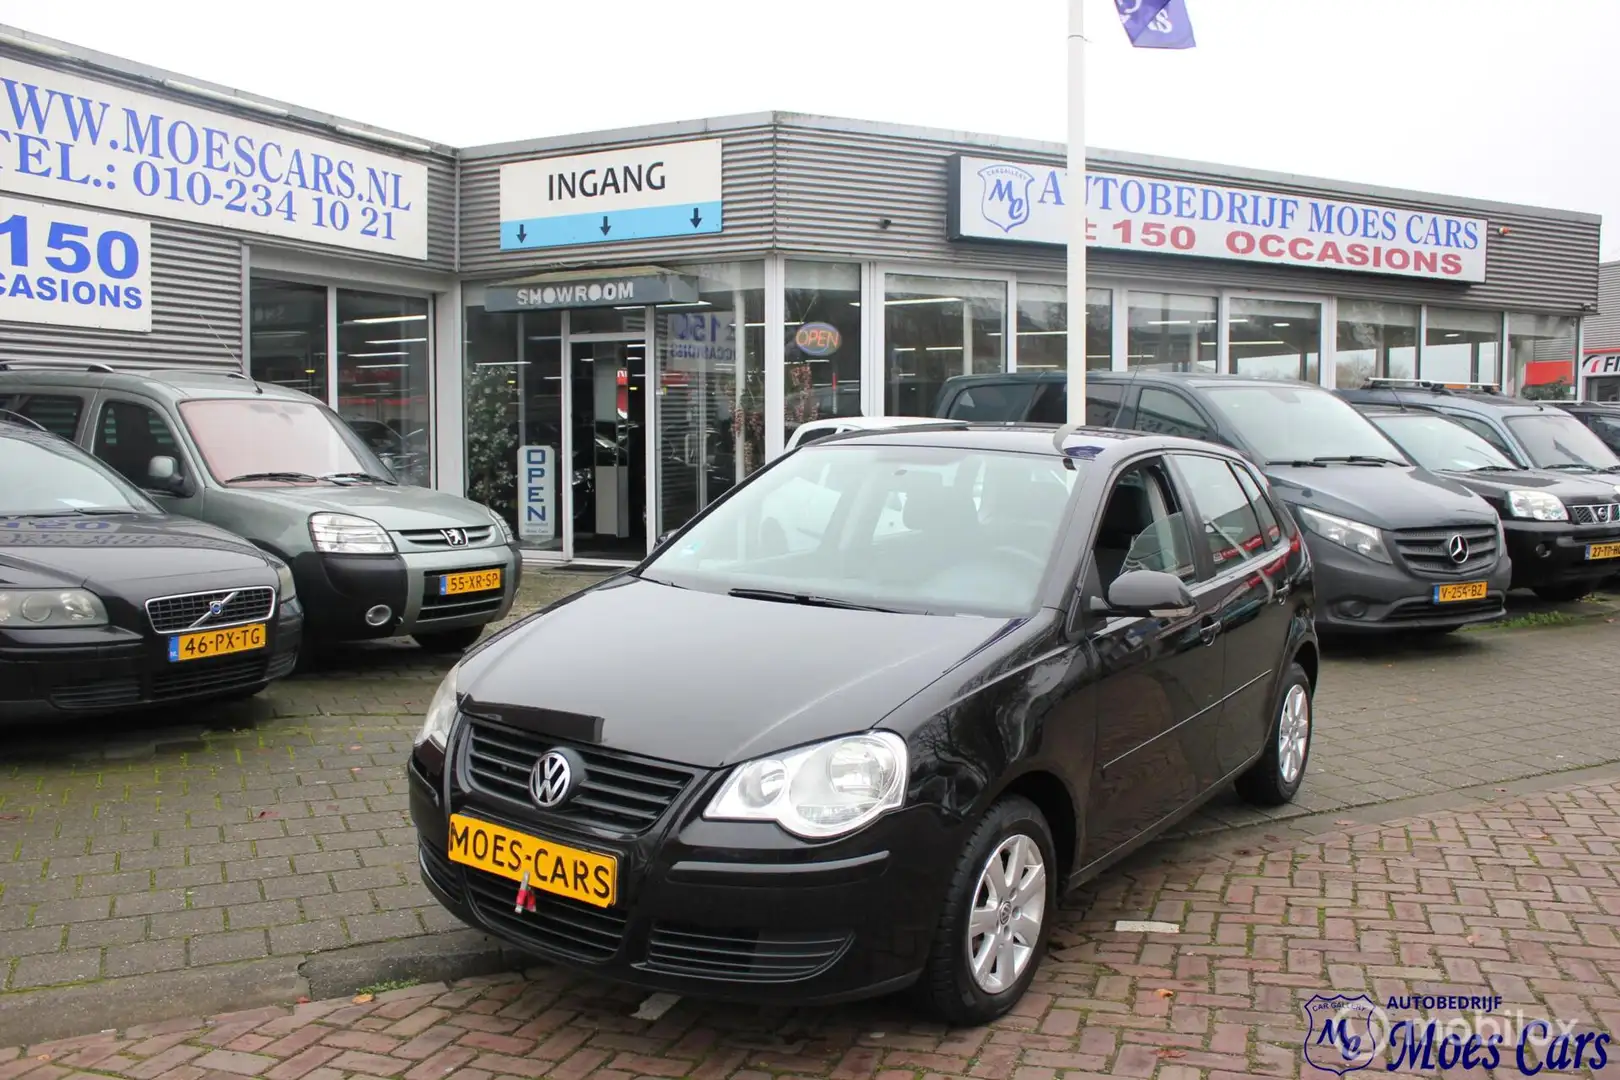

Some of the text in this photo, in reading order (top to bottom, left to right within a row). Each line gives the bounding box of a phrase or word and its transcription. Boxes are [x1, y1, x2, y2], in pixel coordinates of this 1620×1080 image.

[133, 160, 297, 222] 010-234
[311, 197, 349, 231] 10
[360, 207, 396, 241] 21
[548, 161, 666, 201] INGANG
[1038, 170, 1478, 250] ATOBEDRIJF MOES CARS
[1113, 219, 1196, 250] 150
[1226, 231, 1462, 275] OCCASIONS
[516, 282, 634, 305] SHOWROOM
[795, 328, 839, 348] OPEN
[527, 449, 546, 521] OPEN
[451, 573, 498, 591] 55-XR-SP
[1441, 584, 1483, 599] V-254-BZ
[185, 628, 260, 655] 46-PX-TG
[449, 822, 611, 899] MOES-CARS
